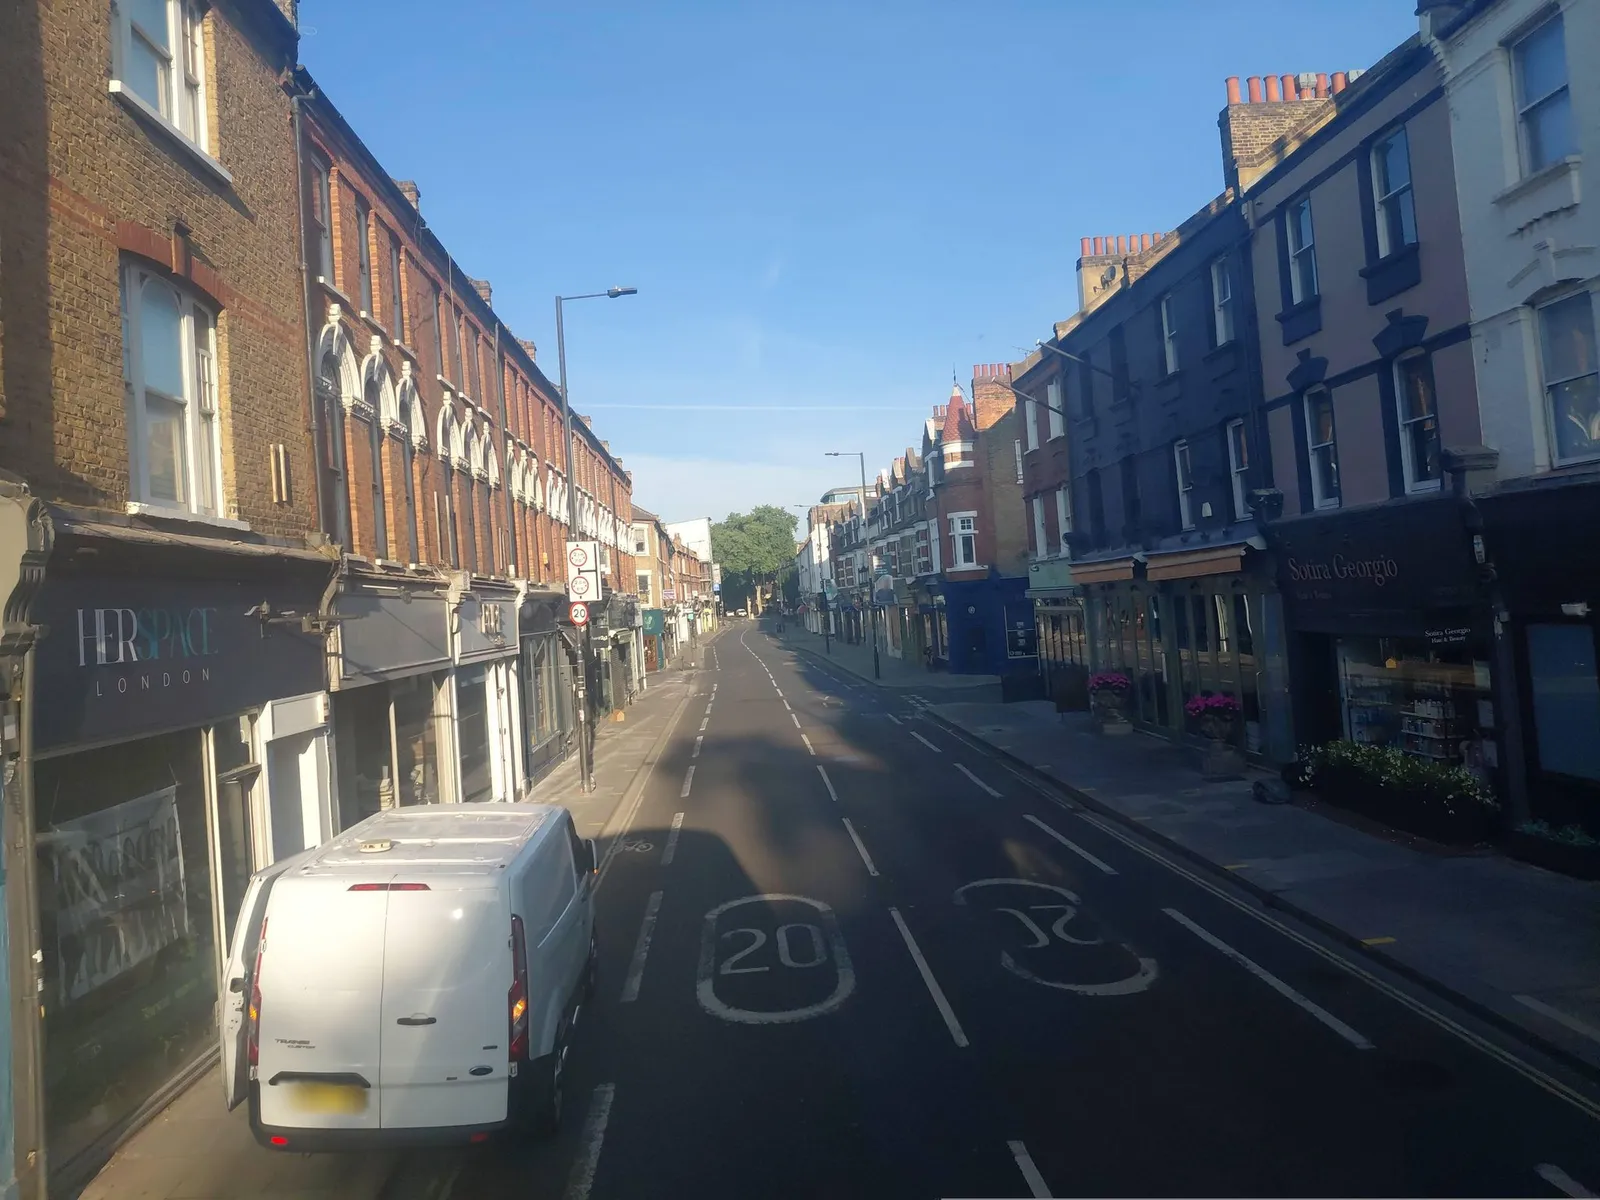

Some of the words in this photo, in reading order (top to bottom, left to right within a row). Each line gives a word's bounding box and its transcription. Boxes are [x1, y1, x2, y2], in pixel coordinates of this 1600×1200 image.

[1289, 557, 1332, 580] Sotira
[1333, 553, 1398, 587] Georgio
[573, 608, 586, 618] 20
[96, 668, 209, 696] LONDON
[720, 923, 828, 975] 20
